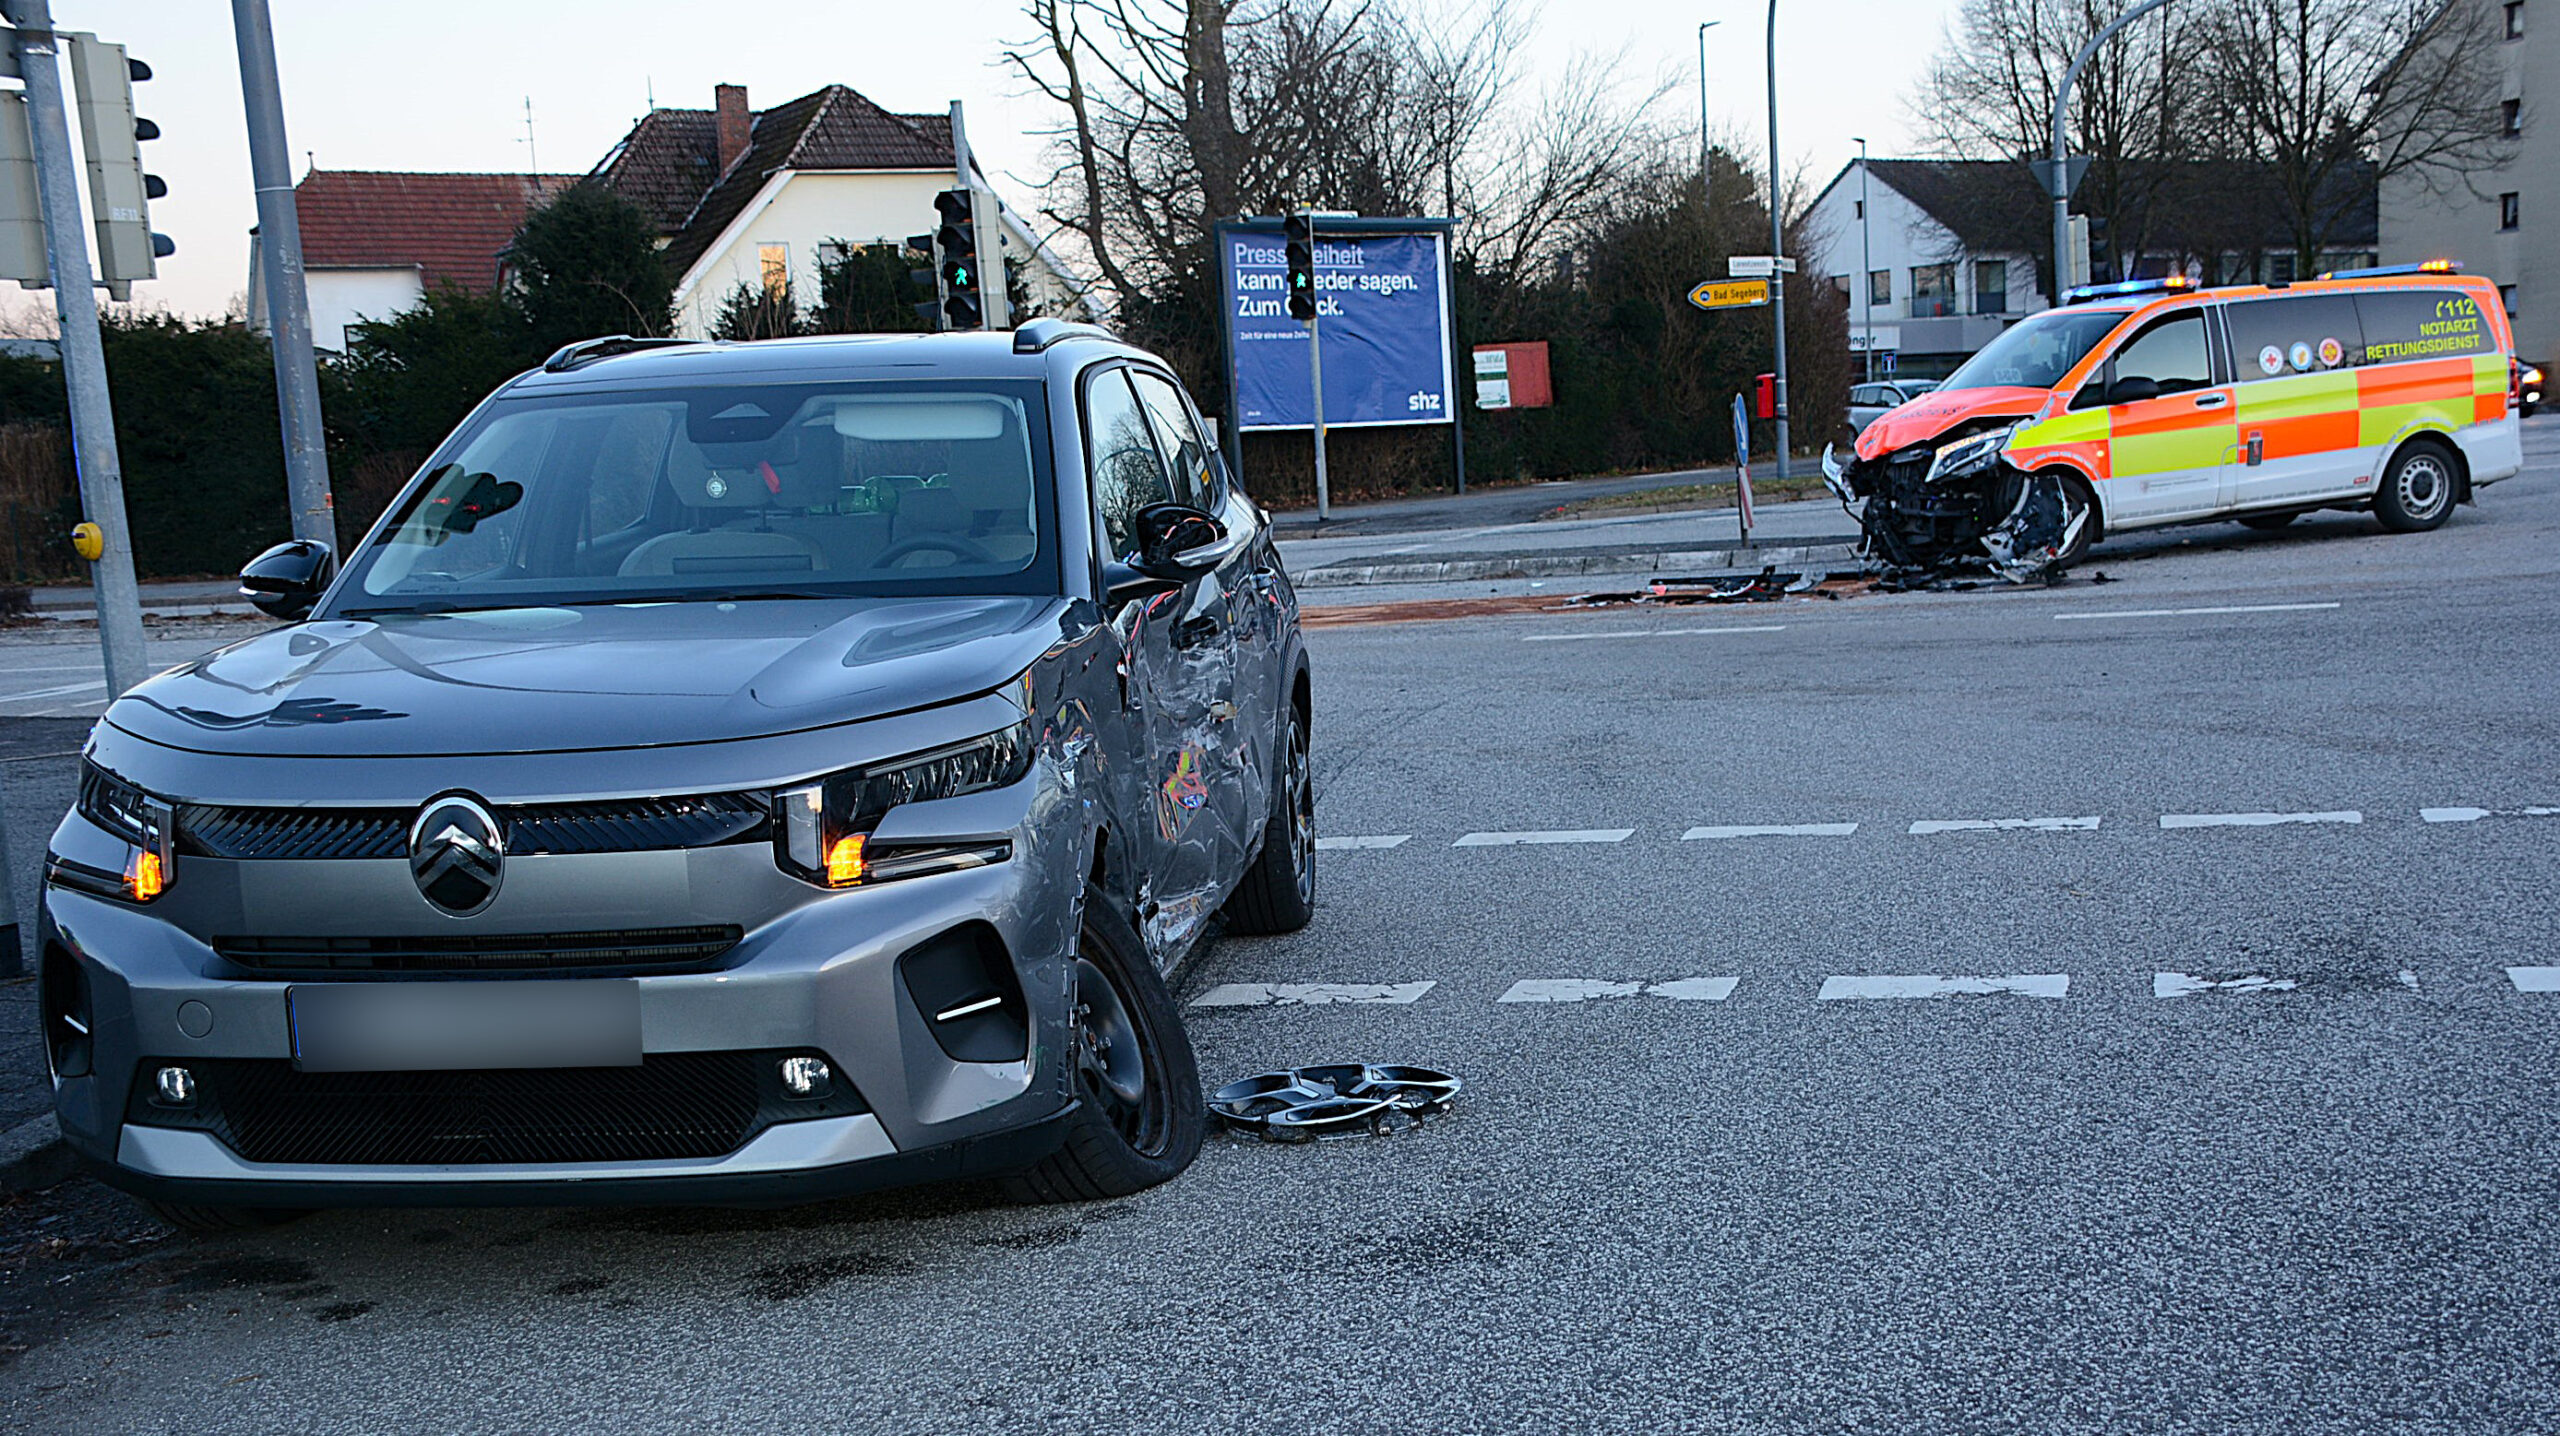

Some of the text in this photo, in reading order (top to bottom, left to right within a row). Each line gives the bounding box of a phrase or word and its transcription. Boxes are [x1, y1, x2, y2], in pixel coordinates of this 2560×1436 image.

[1235, 243, 1365, 265] Presseiheit
[1237, 270, 1284, 290] kann
[1314, 271, 1356, 290] eder
[1360, 274, 1418, 296] sagen.
[1714, 287, 1766, 300] Bad Segeberg
[1238, 296, 1281, 316] Zum
[2444, 298, 2476, 317] 112
[2420, 318, 2478, 337] NOTARZT
[2366, 334, 2480, 360] RETTUNGSDIENST
[1408, 389, 1440, 411] shz
